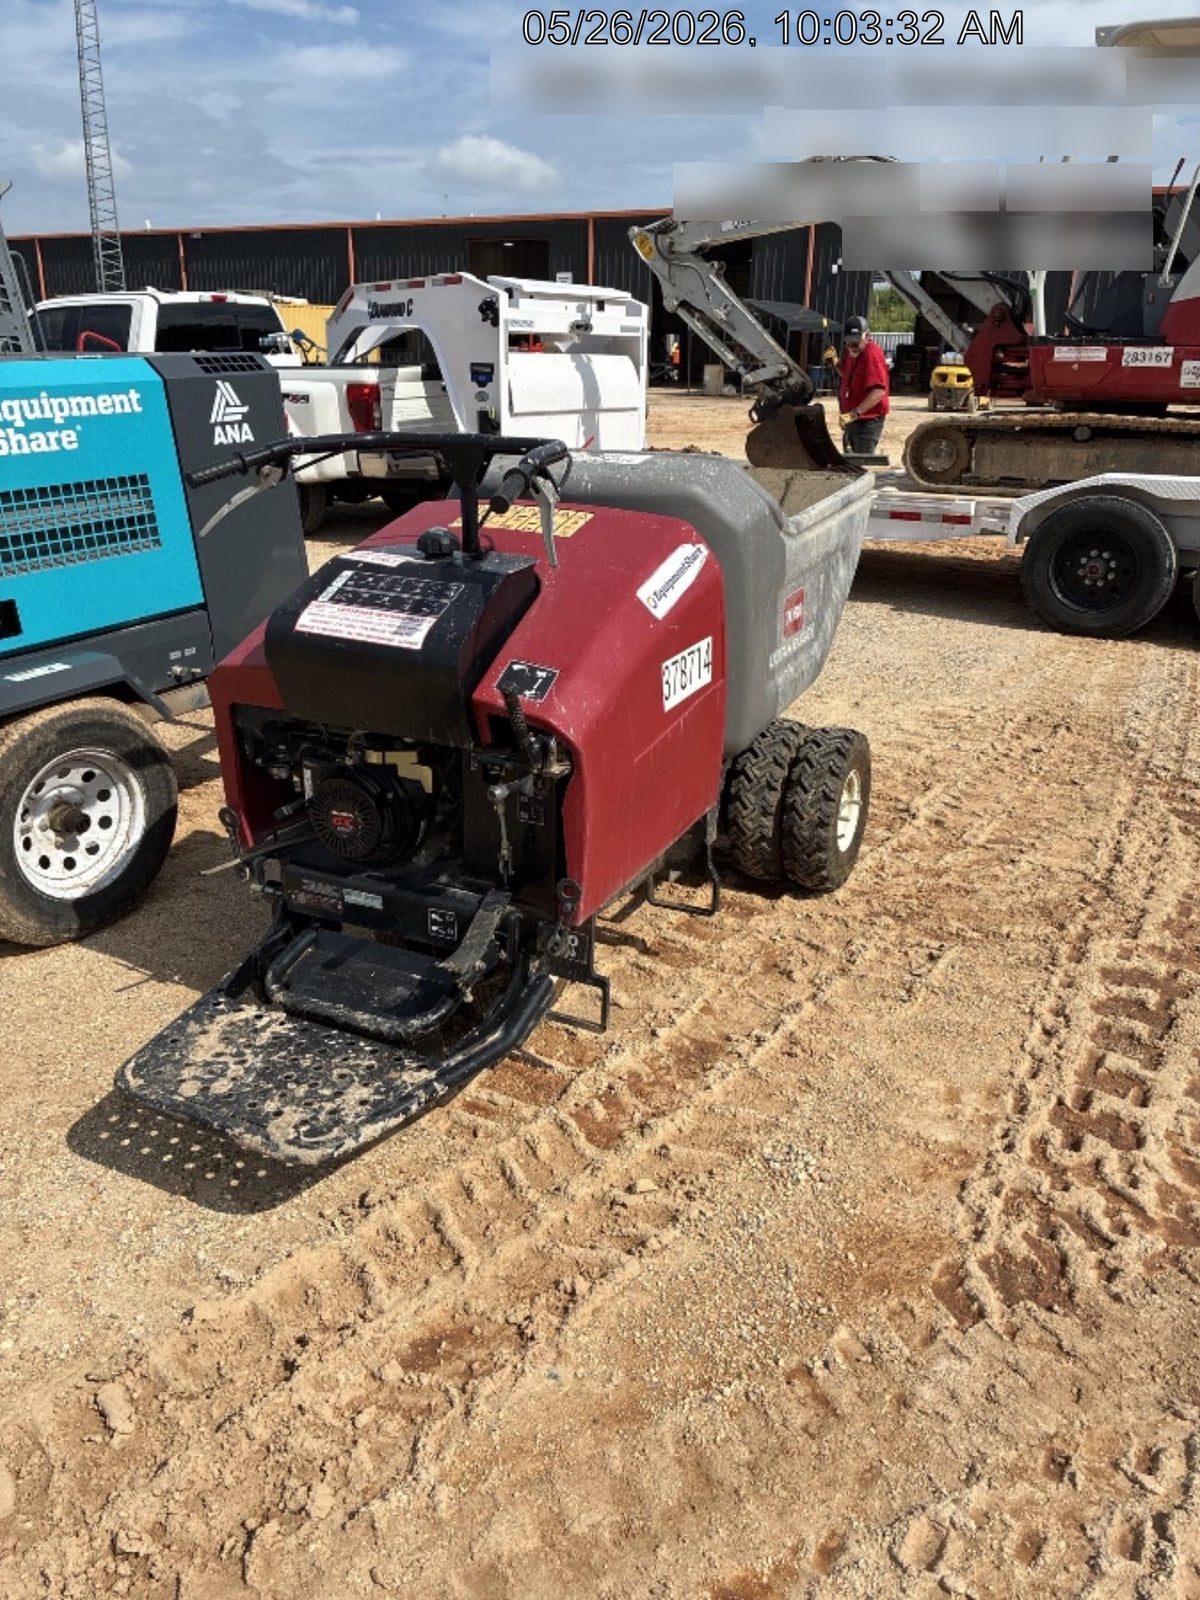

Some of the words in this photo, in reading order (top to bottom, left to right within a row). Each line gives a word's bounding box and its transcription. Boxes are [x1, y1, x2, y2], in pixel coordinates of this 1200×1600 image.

[1124, 351, 1171, 367] 283167
[0, 388, 142, 427] quipment
[214, 422, 254, 445] ANA
[653, 546, 703, 602] EquipmentShare
[662, 641, 712, 701] 378714
